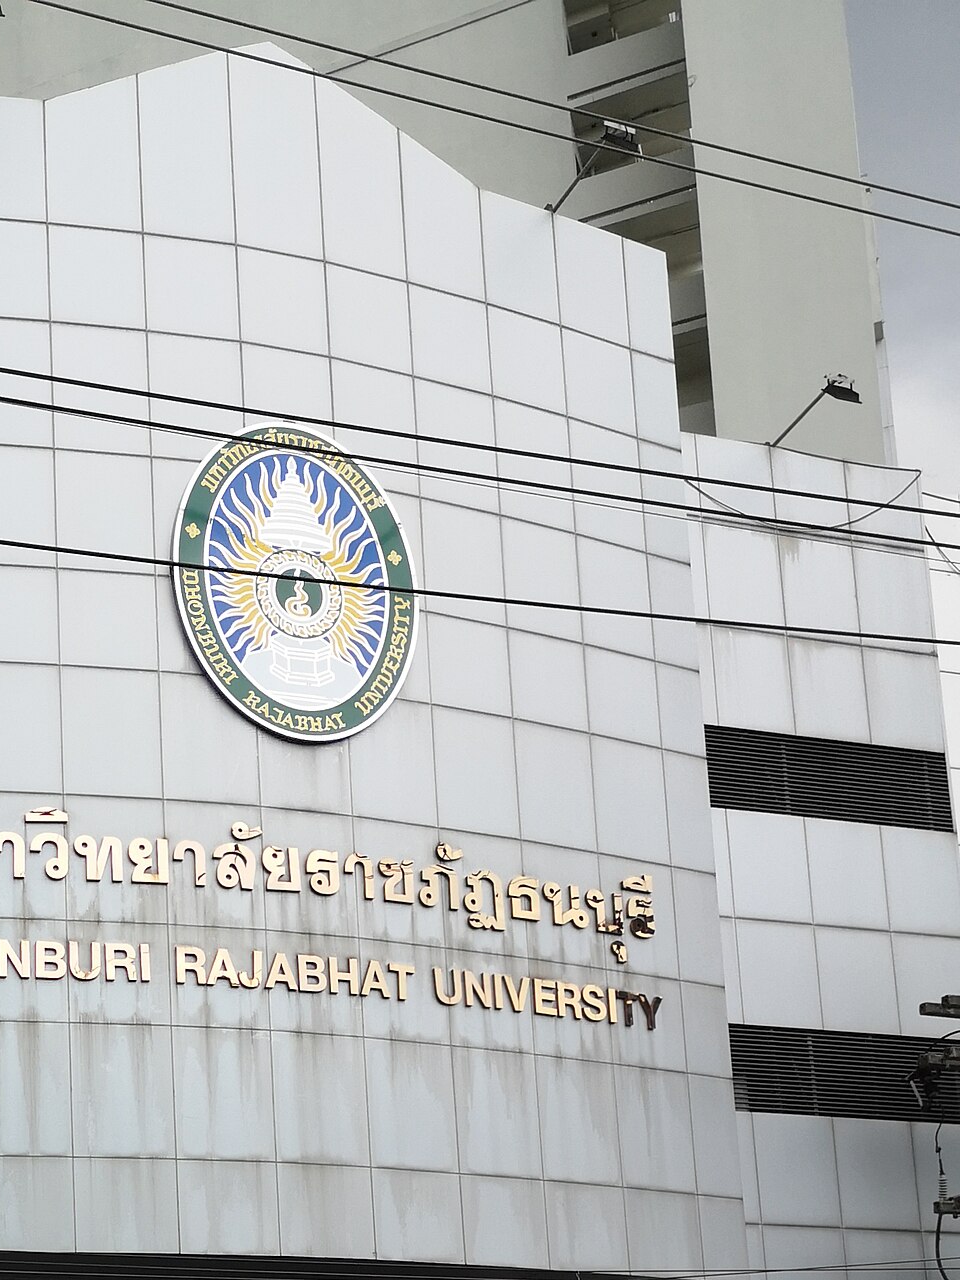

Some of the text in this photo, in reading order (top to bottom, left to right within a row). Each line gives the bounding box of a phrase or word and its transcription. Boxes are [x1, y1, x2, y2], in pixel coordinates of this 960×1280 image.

[181, 569, 411, 732] DHONBURI RAJABHAT UNIVERSITY
[175, 945, 415, 1001] RAJABHAT
[431, 966, 664, 1031] UNIVERSITY
